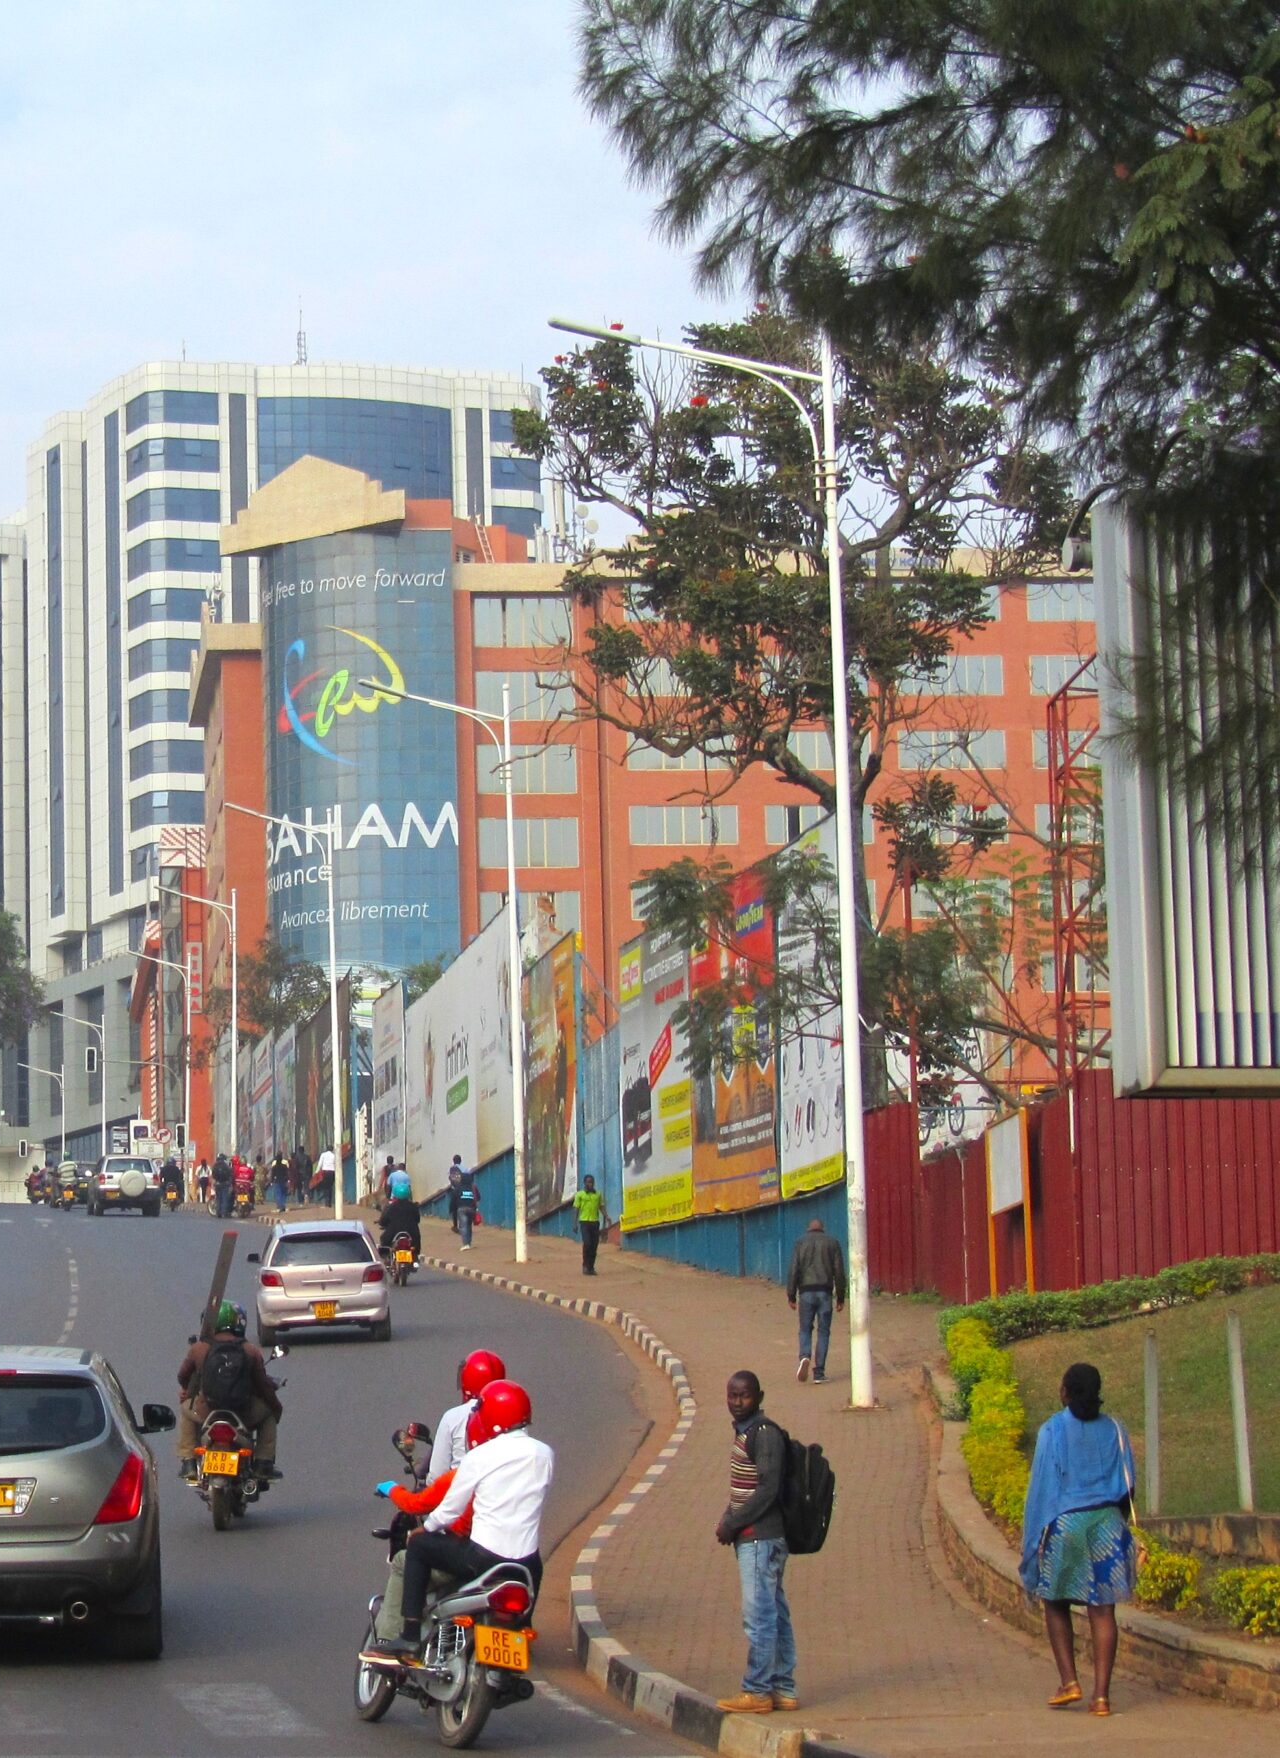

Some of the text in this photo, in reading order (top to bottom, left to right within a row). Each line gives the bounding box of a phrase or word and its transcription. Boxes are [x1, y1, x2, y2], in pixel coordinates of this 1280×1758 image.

[275, 581, 295, 606] free
[300, 579, 314, 595] to
[320, 574, 367, 593] move
[374, 568, 446, 592] forward
[341, 900, 430, 921] librement
[492, 1630, 511, 1648] RE
